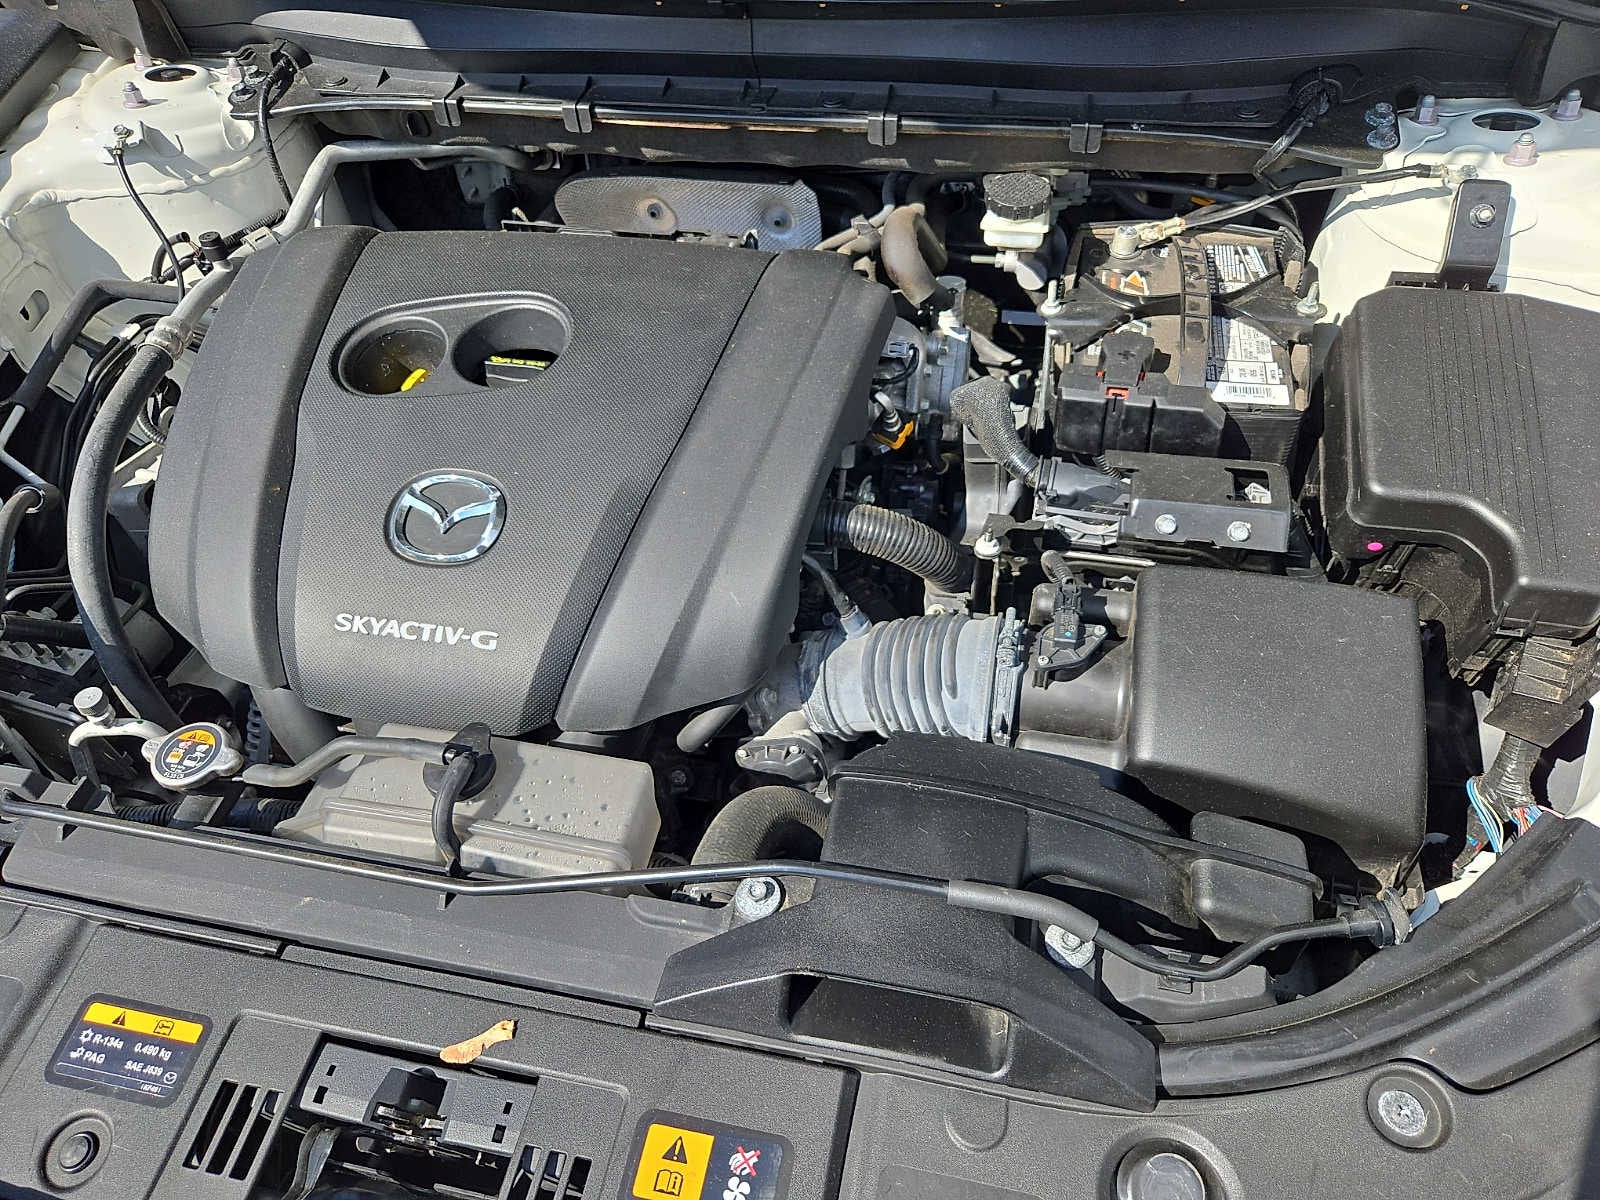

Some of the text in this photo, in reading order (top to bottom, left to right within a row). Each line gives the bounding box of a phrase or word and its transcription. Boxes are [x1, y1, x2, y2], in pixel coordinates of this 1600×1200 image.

[334, 613, 500, 651] SKYACTIV-G
[83, 1050, 106, 1064] PAG
[92, 1033, 125, 1050] R-134a
[158, 1047, 173, 1062] kg
[123, 1060, 144, 1072] SAE
